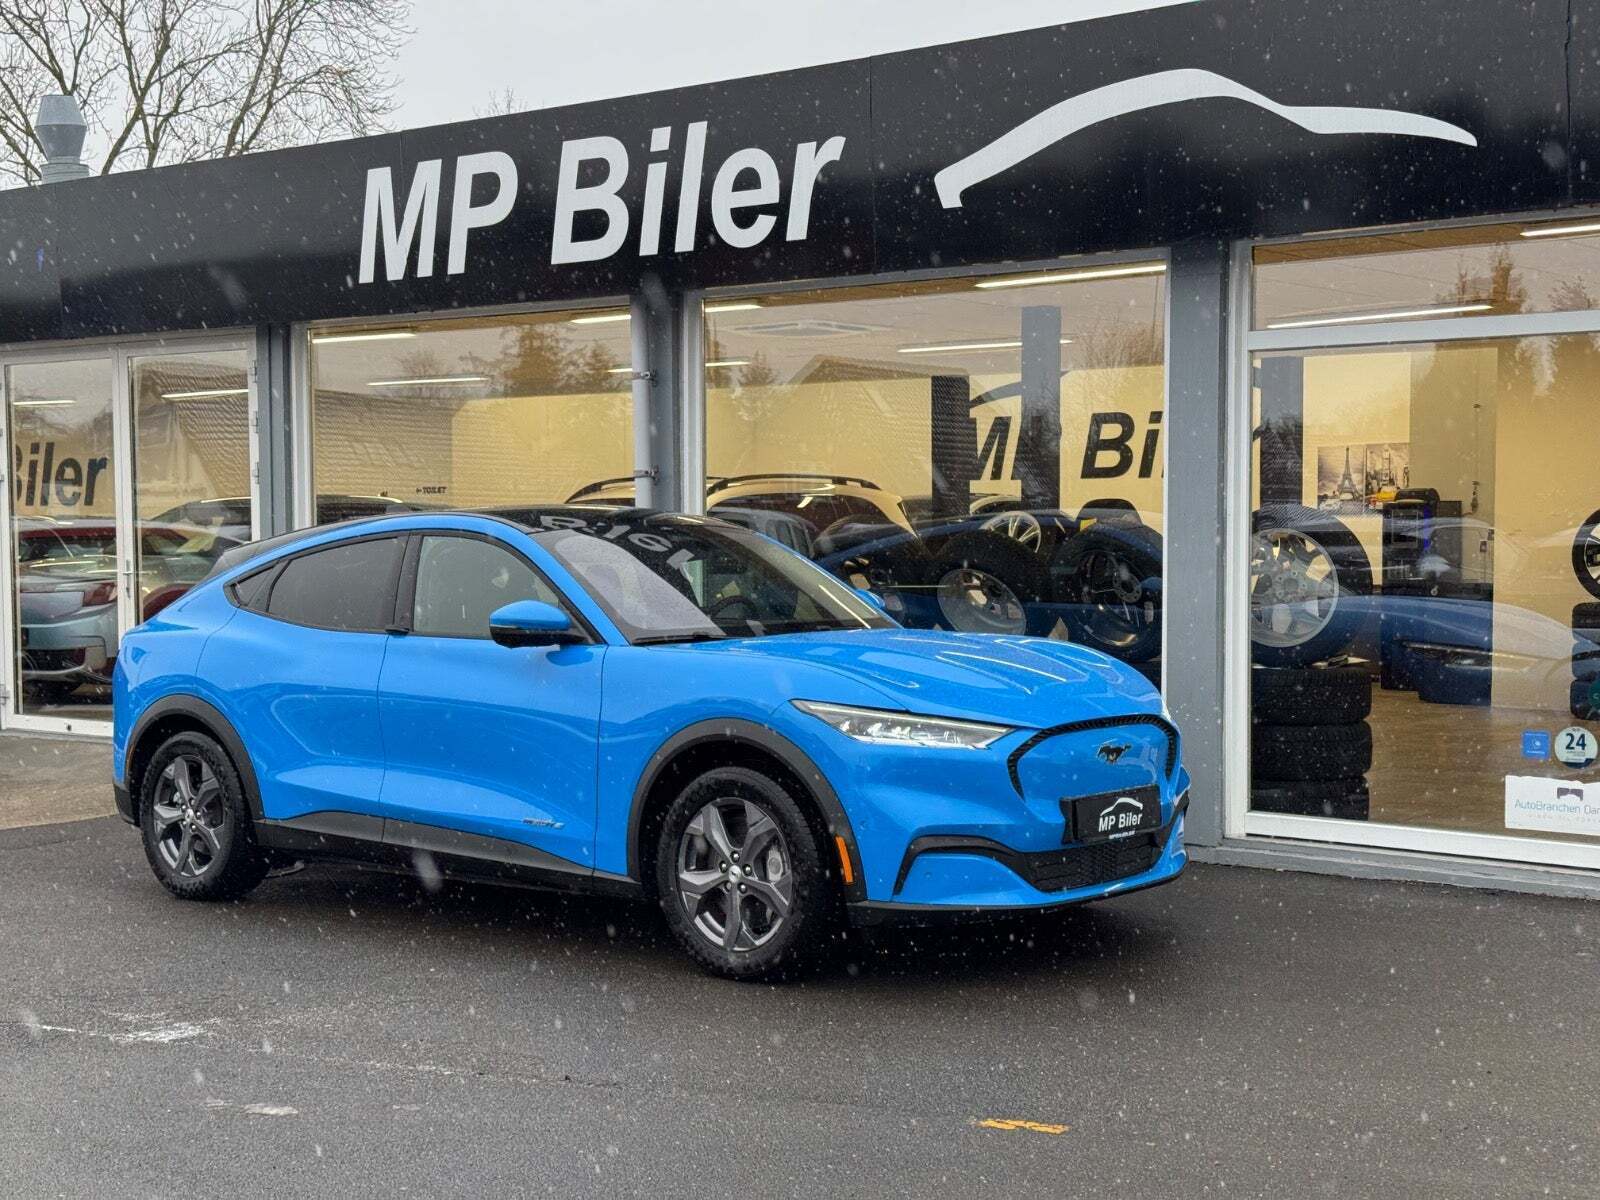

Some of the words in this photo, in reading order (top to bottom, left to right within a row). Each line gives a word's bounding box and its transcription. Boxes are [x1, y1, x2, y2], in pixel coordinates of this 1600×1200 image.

[358, 151, 519, 284] MP
[551, 120, 847, 265] Biler
[1565, 733, 1587, 750] 24
[1099, 815, 1116, 832] MP
[1118, 812, 1142, 828] Biler
